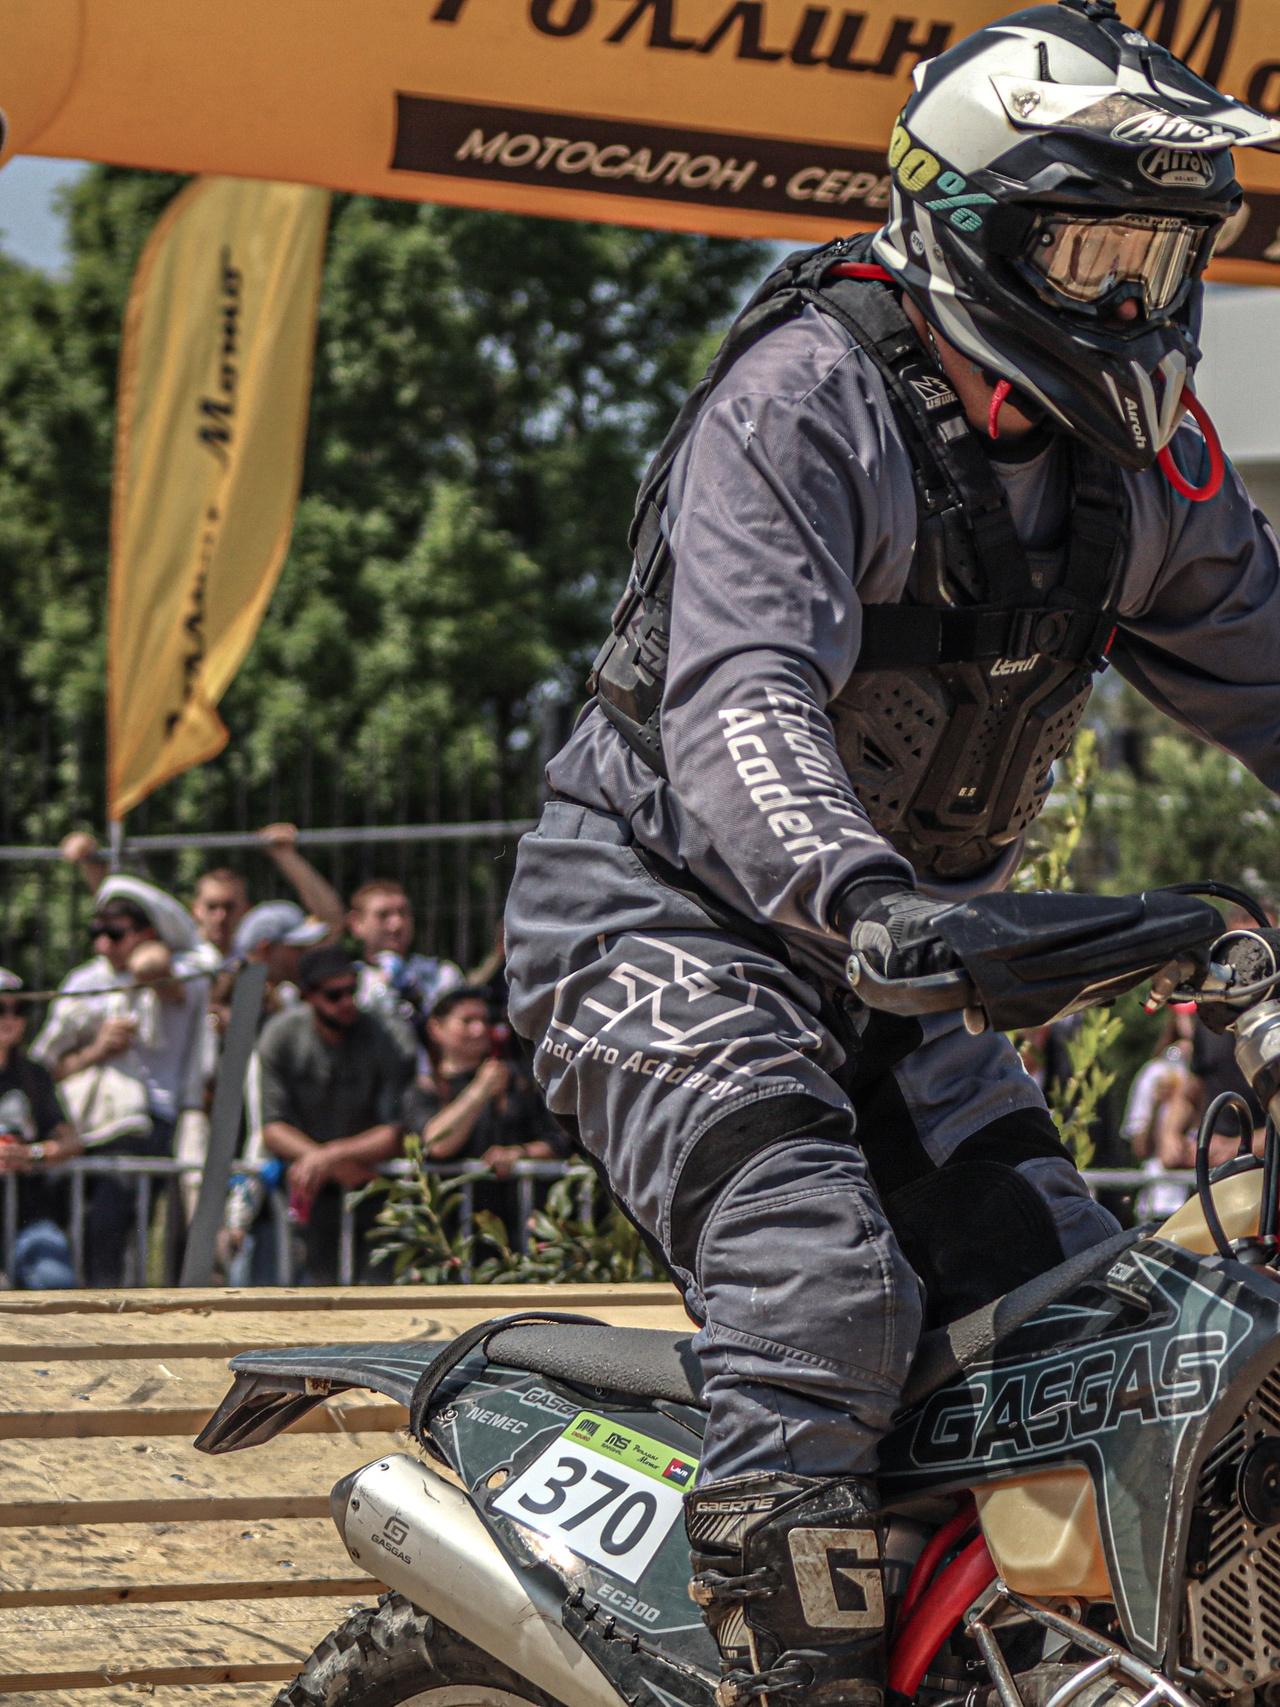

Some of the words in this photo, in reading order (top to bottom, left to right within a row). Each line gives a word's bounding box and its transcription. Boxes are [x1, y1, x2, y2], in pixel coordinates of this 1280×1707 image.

[455, 128, 757, 192] МОТОСАЛОН
[1124, 396, 1148, 450] Airoh
[577, 1035, 621, 1066] Pro
[620, 1050, 744, 1101] Academy
[465, 1405, 529, 1435] NEMEC
[908, 1330, 1228, 1469] GASGAS
[669, 1464, 689, 1478] LAVR
[517, 1456, 658, 1557] 370
[371, 1533, 412, 1565] GASGAS
[596, 1582, 661, 1623] EC300
